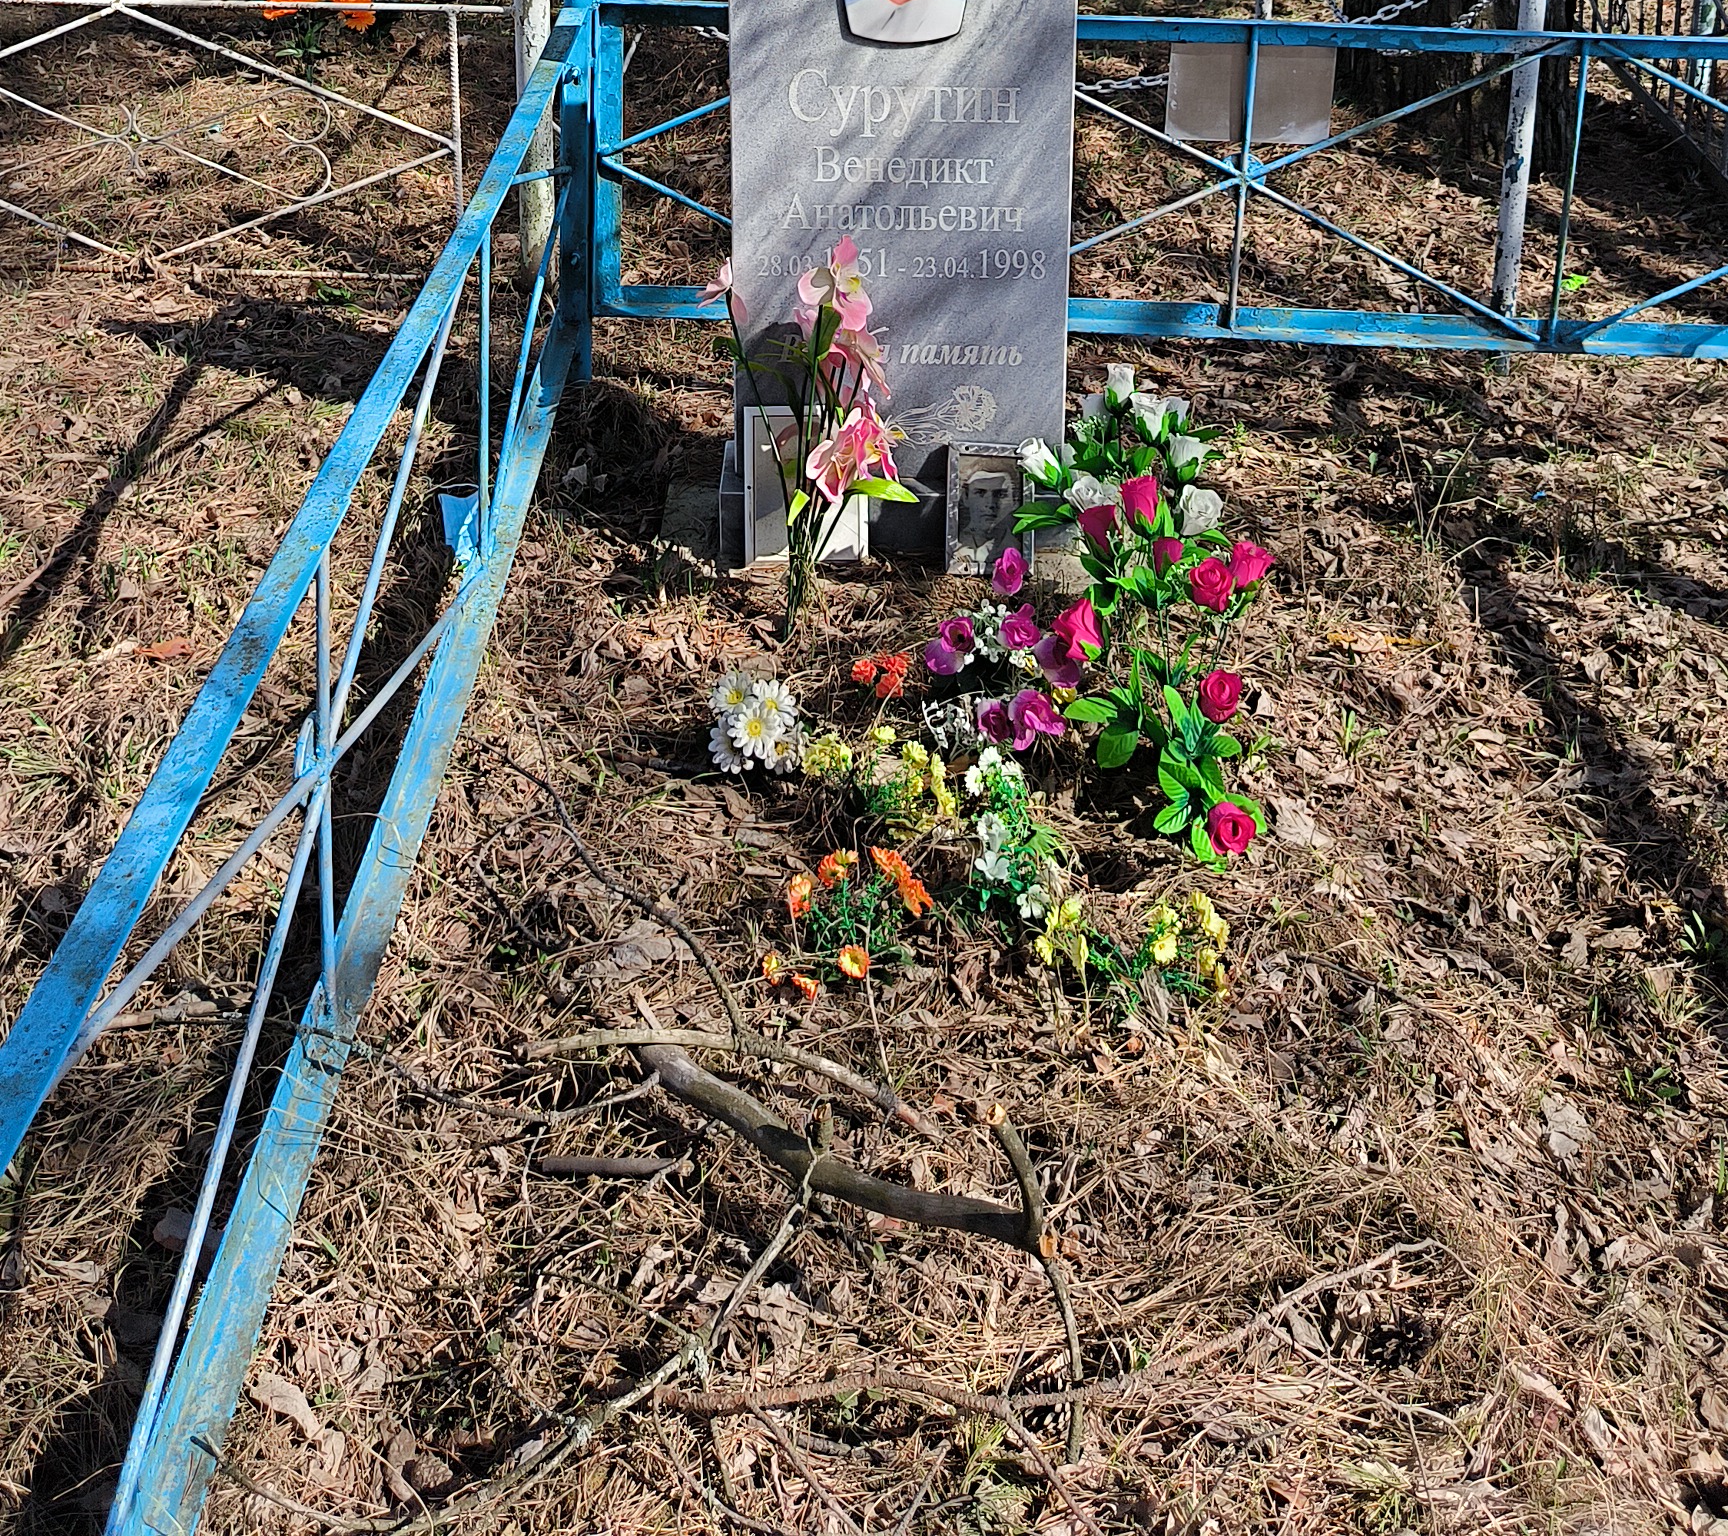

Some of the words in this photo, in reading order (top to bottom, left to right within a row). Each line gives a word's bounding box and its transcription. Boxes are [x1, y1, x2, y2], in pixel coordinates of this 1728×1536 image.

[787, 68, 1021, 138] Сурутин
[813, 146, 994, 190] Венедикт
[781, 192, 1025, 233] Анатольевич
[911, 248, 1047, 281] 23.04.1998
[899, 342, 1023, 366] память
